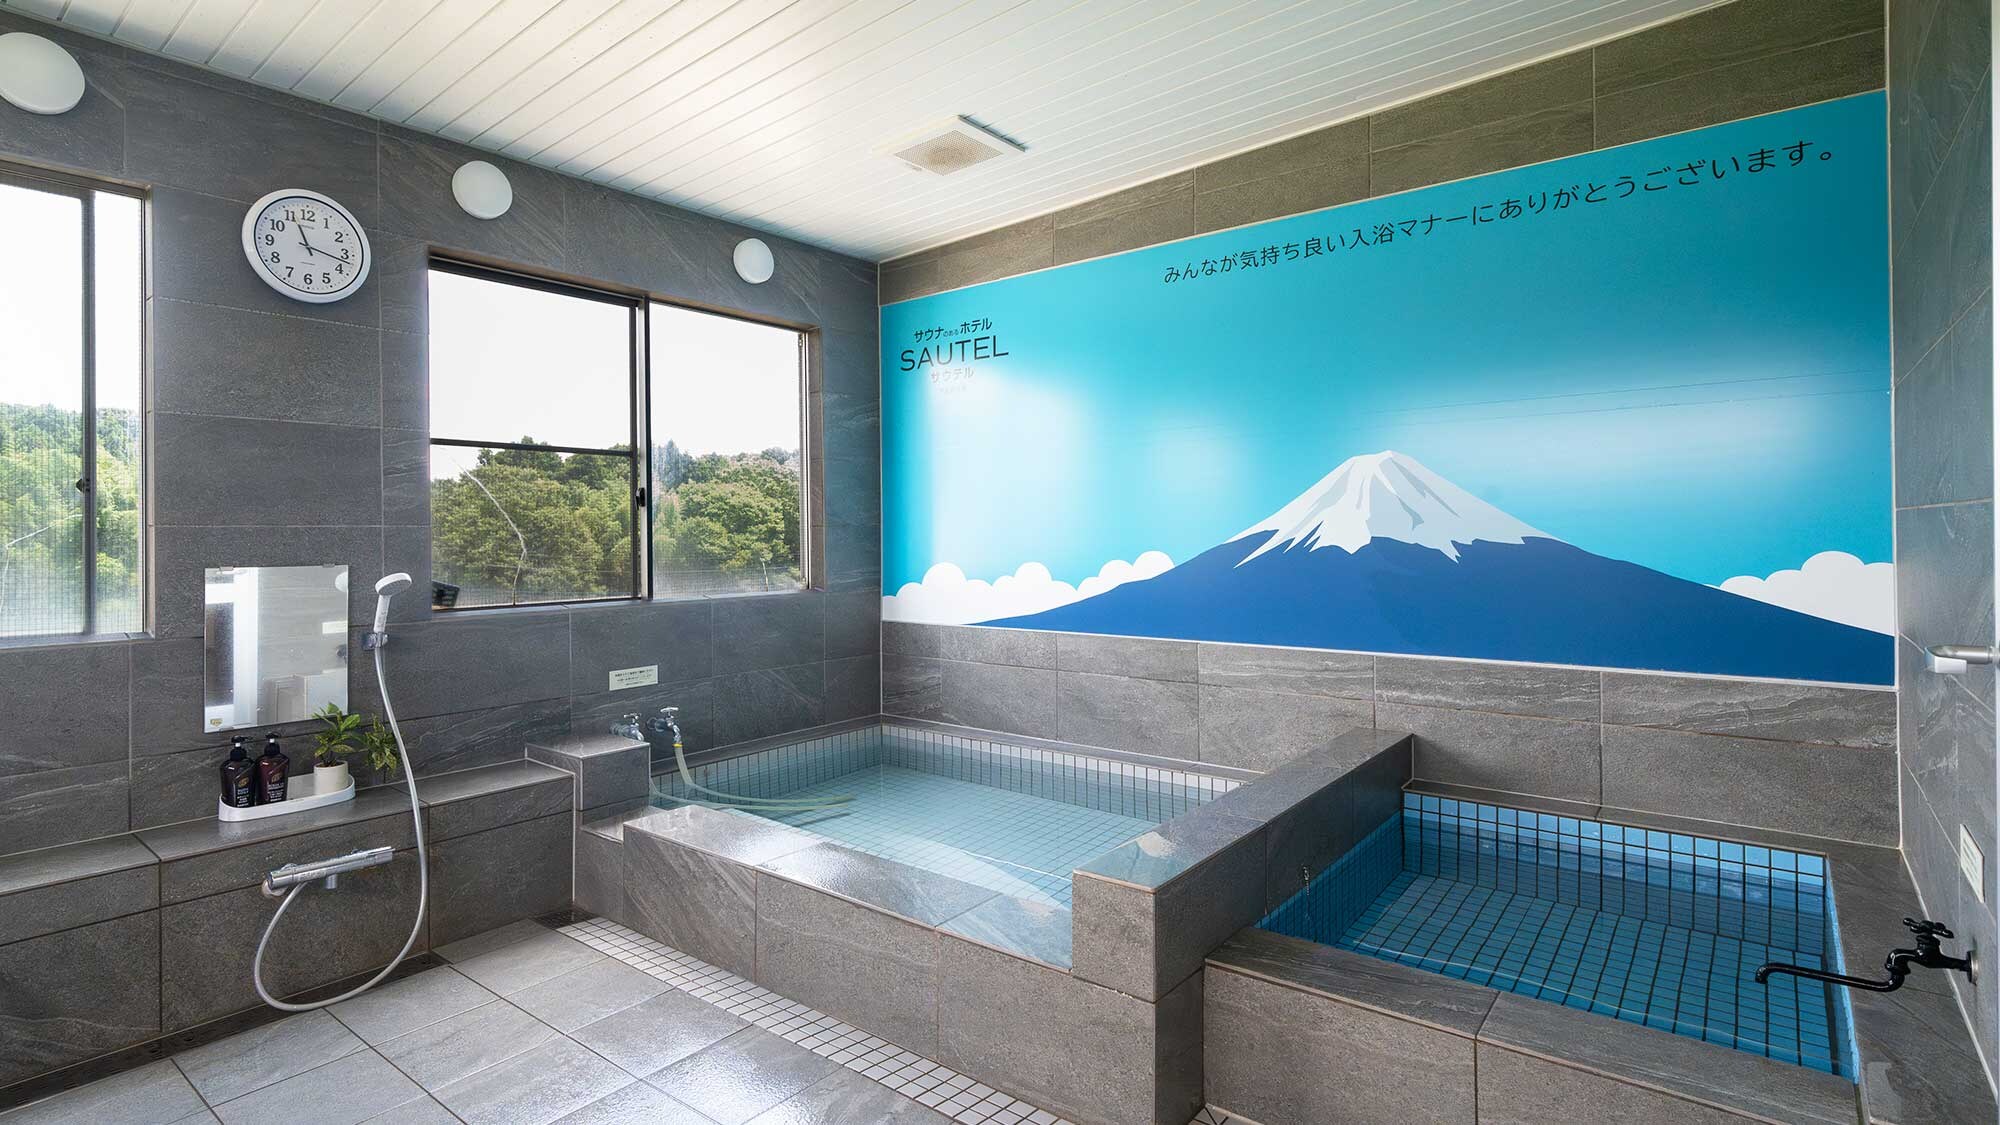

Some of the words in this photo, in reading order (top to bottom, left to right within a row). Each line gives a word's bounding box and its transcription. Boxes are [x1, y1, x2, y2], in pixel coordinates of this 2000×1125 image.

[284, 209, 297, 222] 11
[300, 209, 316, 222] 12
[1164, 140, 1832, 284] みんなが気持ち良い入浴マナーにありがとうございます。
[270, 218, 286, 232] 10
[323, 217, 330, 229] 1
[265, 234, 275, 246] 9
[334, 231, 344, 243] 2
[270, 251, 281, 263] 8
[340, 248, 350, 260] 3
[285, 266, 295, 278] 7
[334, 263, 344, 274] 4
[303, 273, 313, 285] 6
[321, 272, 331, 284] 5
[900, 335, 1009, 371] SAUTEL
